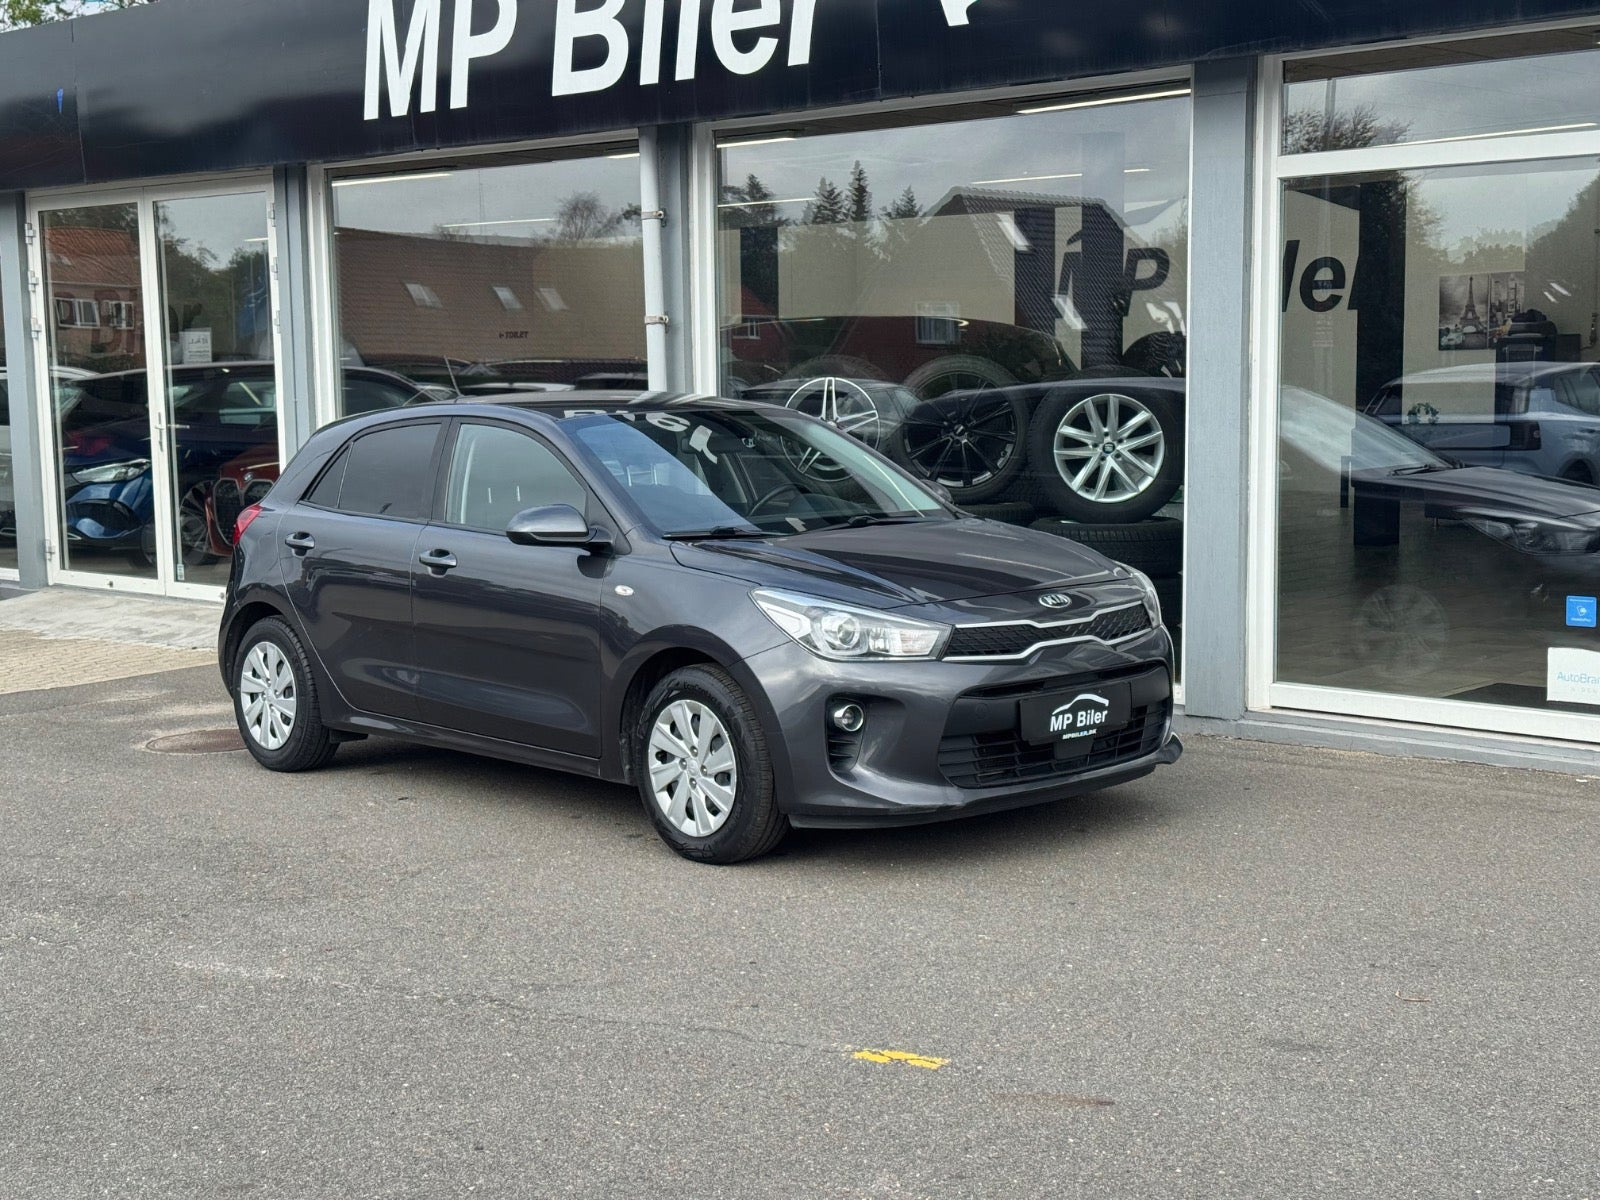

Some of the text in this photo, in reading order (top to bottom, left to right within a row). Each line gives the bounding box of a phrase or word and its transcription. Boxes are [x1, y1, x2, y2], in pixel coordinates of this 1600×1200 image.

[363, 0, 818, 121] MP Biler
[505, 330, 529, 339] TOILET
[1042, 593, 1069, 606] KIA
[1049, 709, 1108, 732] MP Biler
